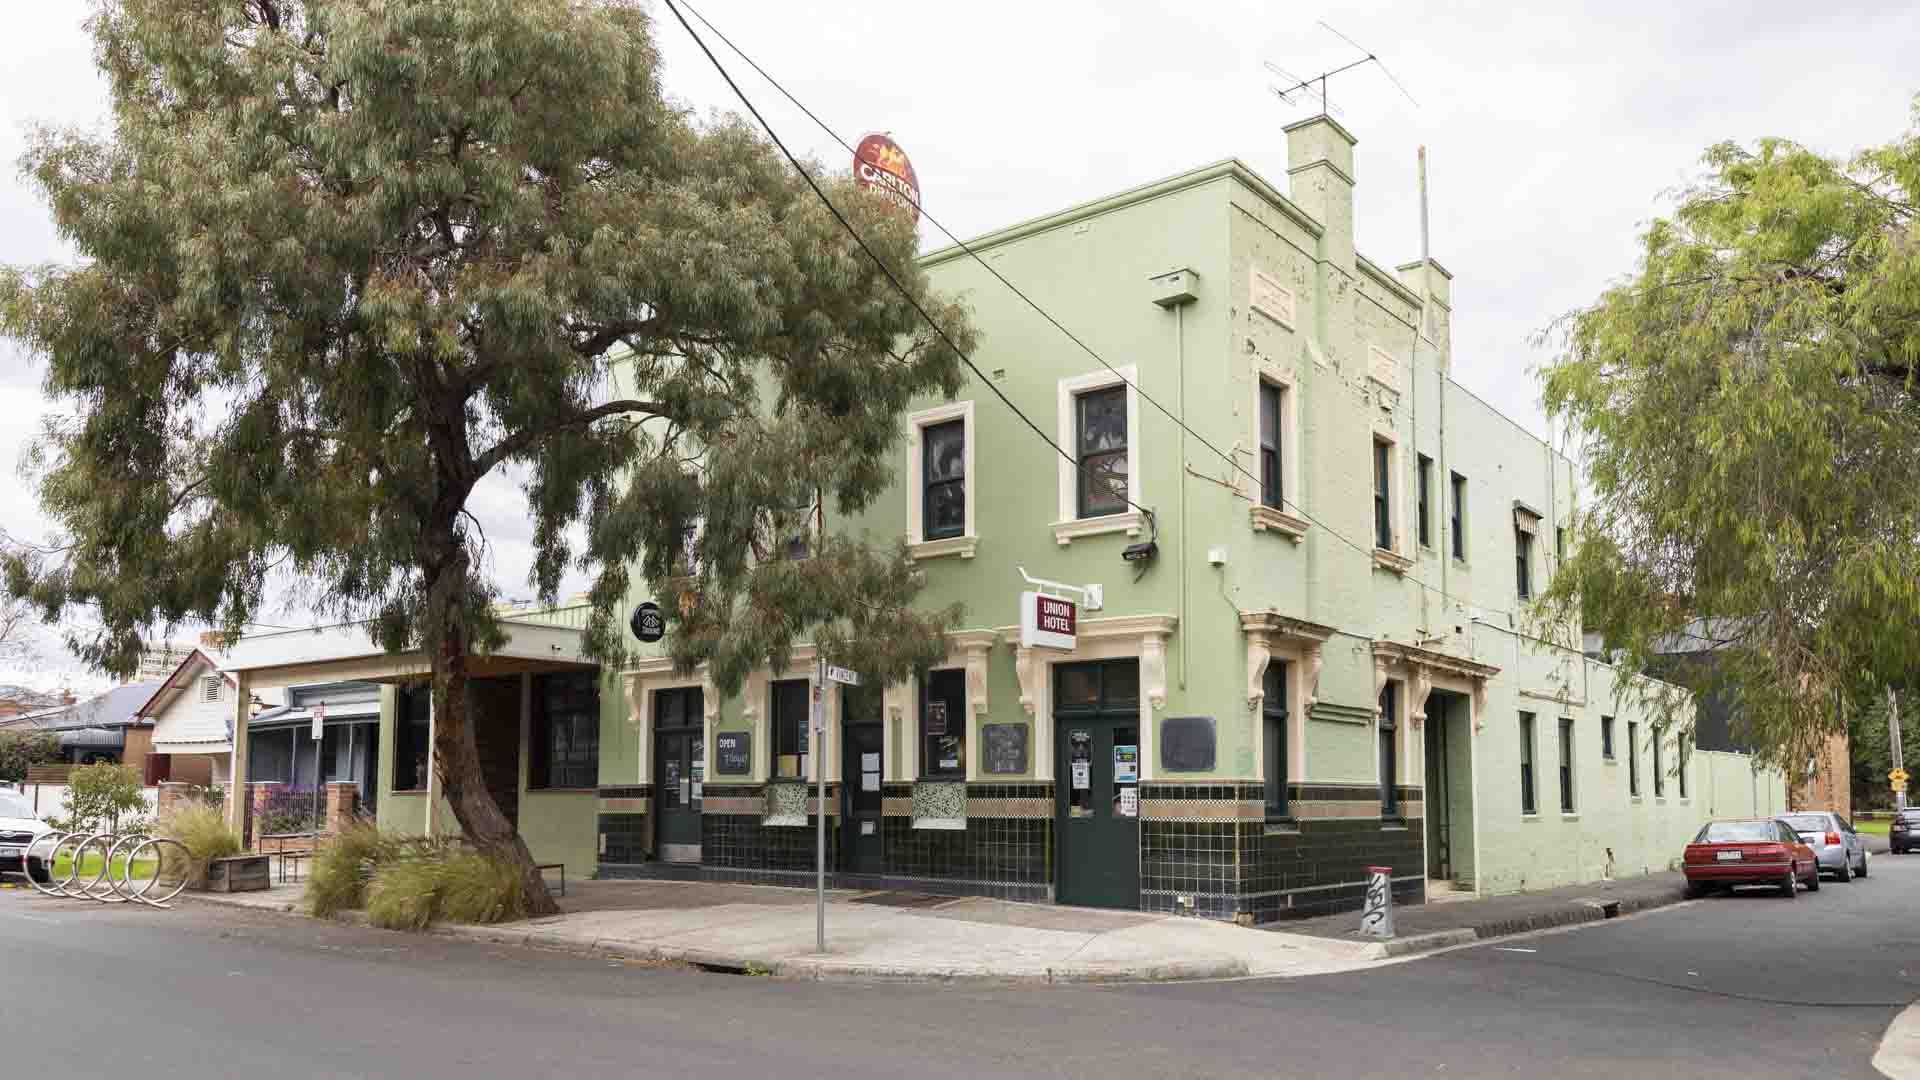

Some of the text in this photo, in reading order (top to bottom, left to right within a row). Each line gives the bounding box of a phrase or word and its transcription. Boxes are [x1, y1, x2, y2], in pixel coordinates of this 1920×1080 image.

[1044, 600, 1070, 617] UNION
[1044, 615, 1070, 632] HOTEL
[719, 738, 736, 749] OPEN
